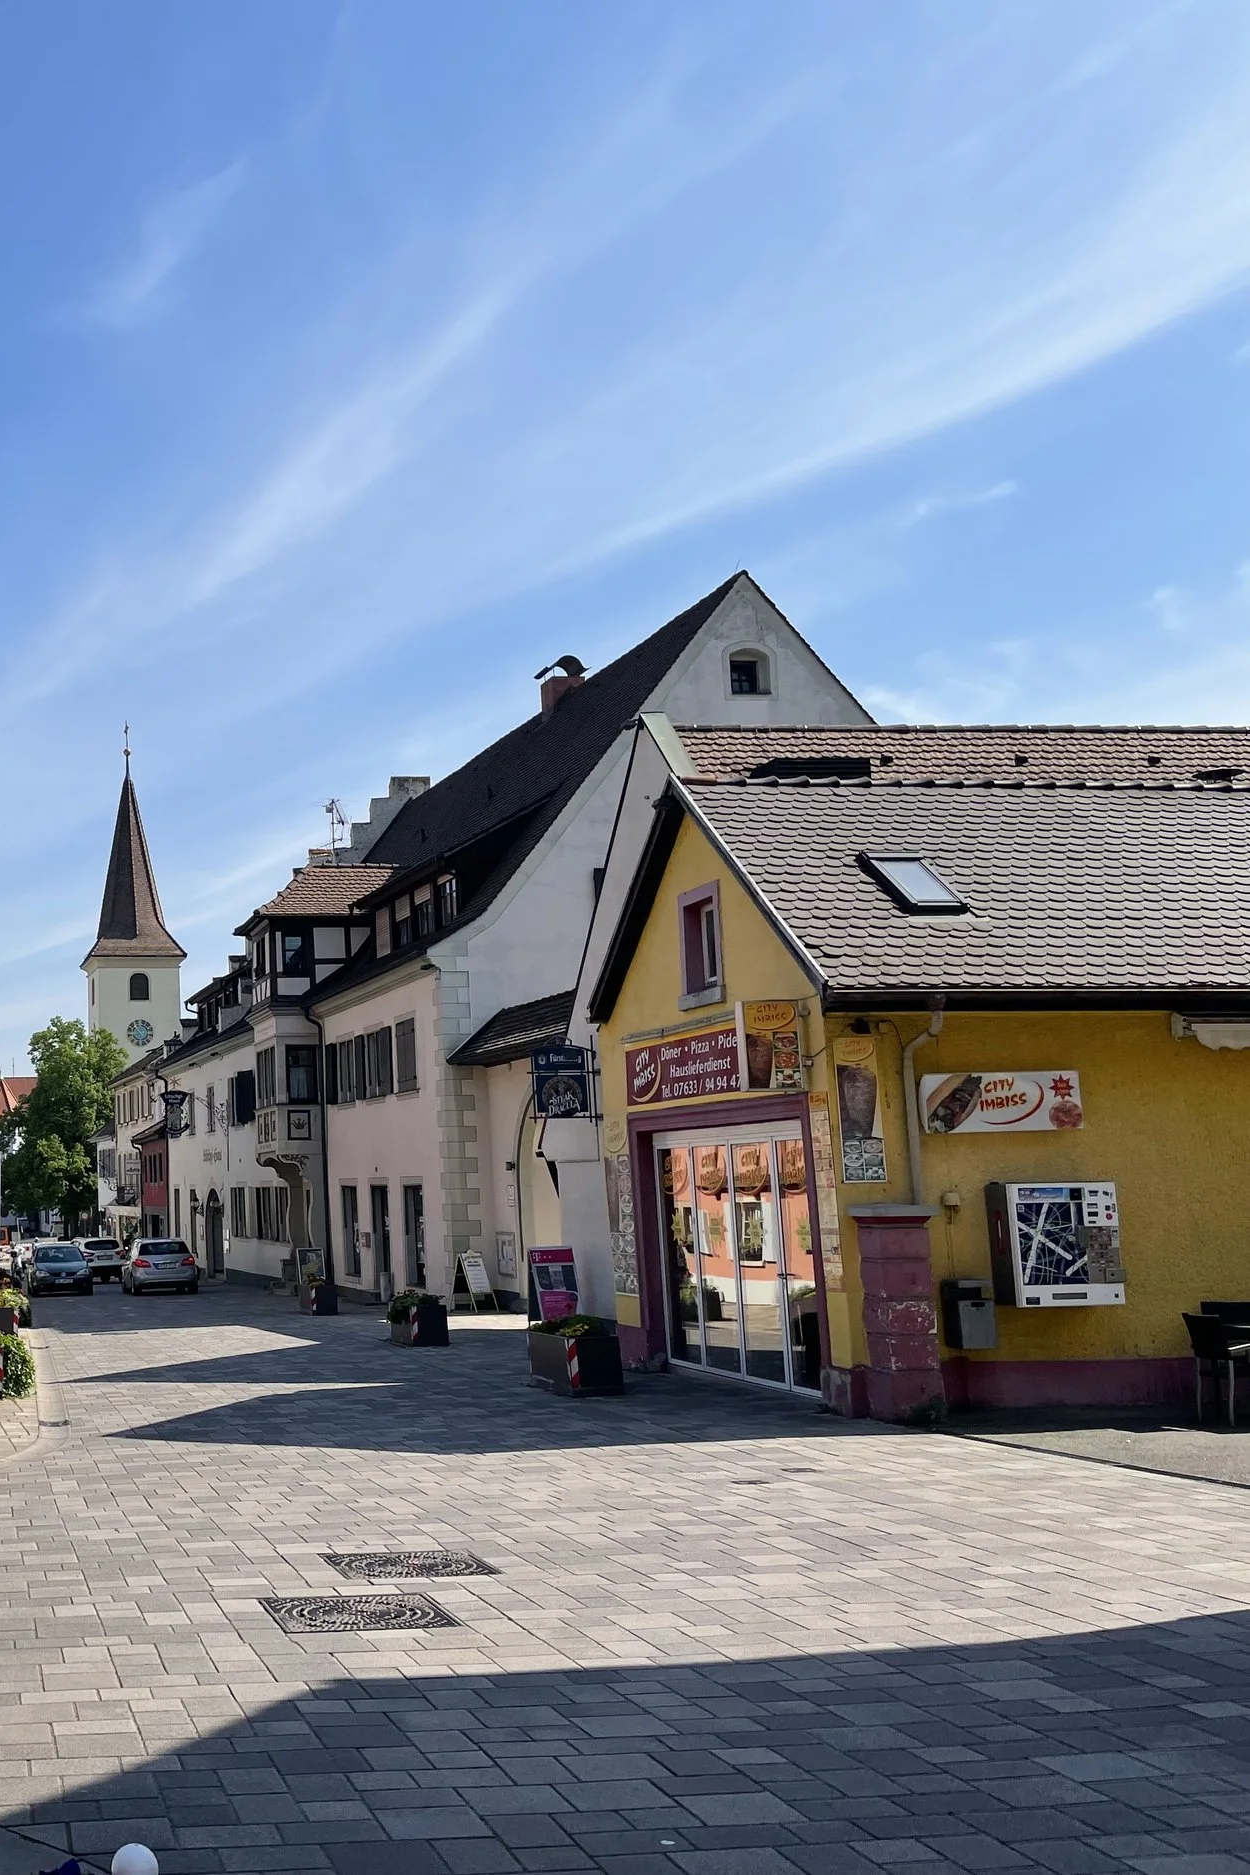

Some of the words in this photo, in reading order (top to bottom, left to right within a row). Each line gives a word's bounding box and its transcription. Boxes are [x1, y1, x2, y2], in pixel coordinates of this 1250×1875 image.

[756, 1003, 778, 1013] CITY
[661, 1046, 682, 1061] Döner
[690, 1040, 710, 1055] Pizza
[718, 1032, 738, 1049] Pide
[635, 1048, 650, 1072] CITY
[670, 1056, 731, 1078] Hauslieferdienst
[633, 1063, 656, 1092] IMBISS
[661, 1085, 673, 1098] Tel.
[673, 1080, 698, 1097] 07633
[705, 1078, 714, 1092] 94
[716, 1075, 728, 1091] 94
[983, 1077, 1014, 1094] CITY
[548, 1099, 581, 1117] DRACULA
[549, 1090, 575, 1105] STEAK
[979, 1092, 1027, 1112] IMBISS
